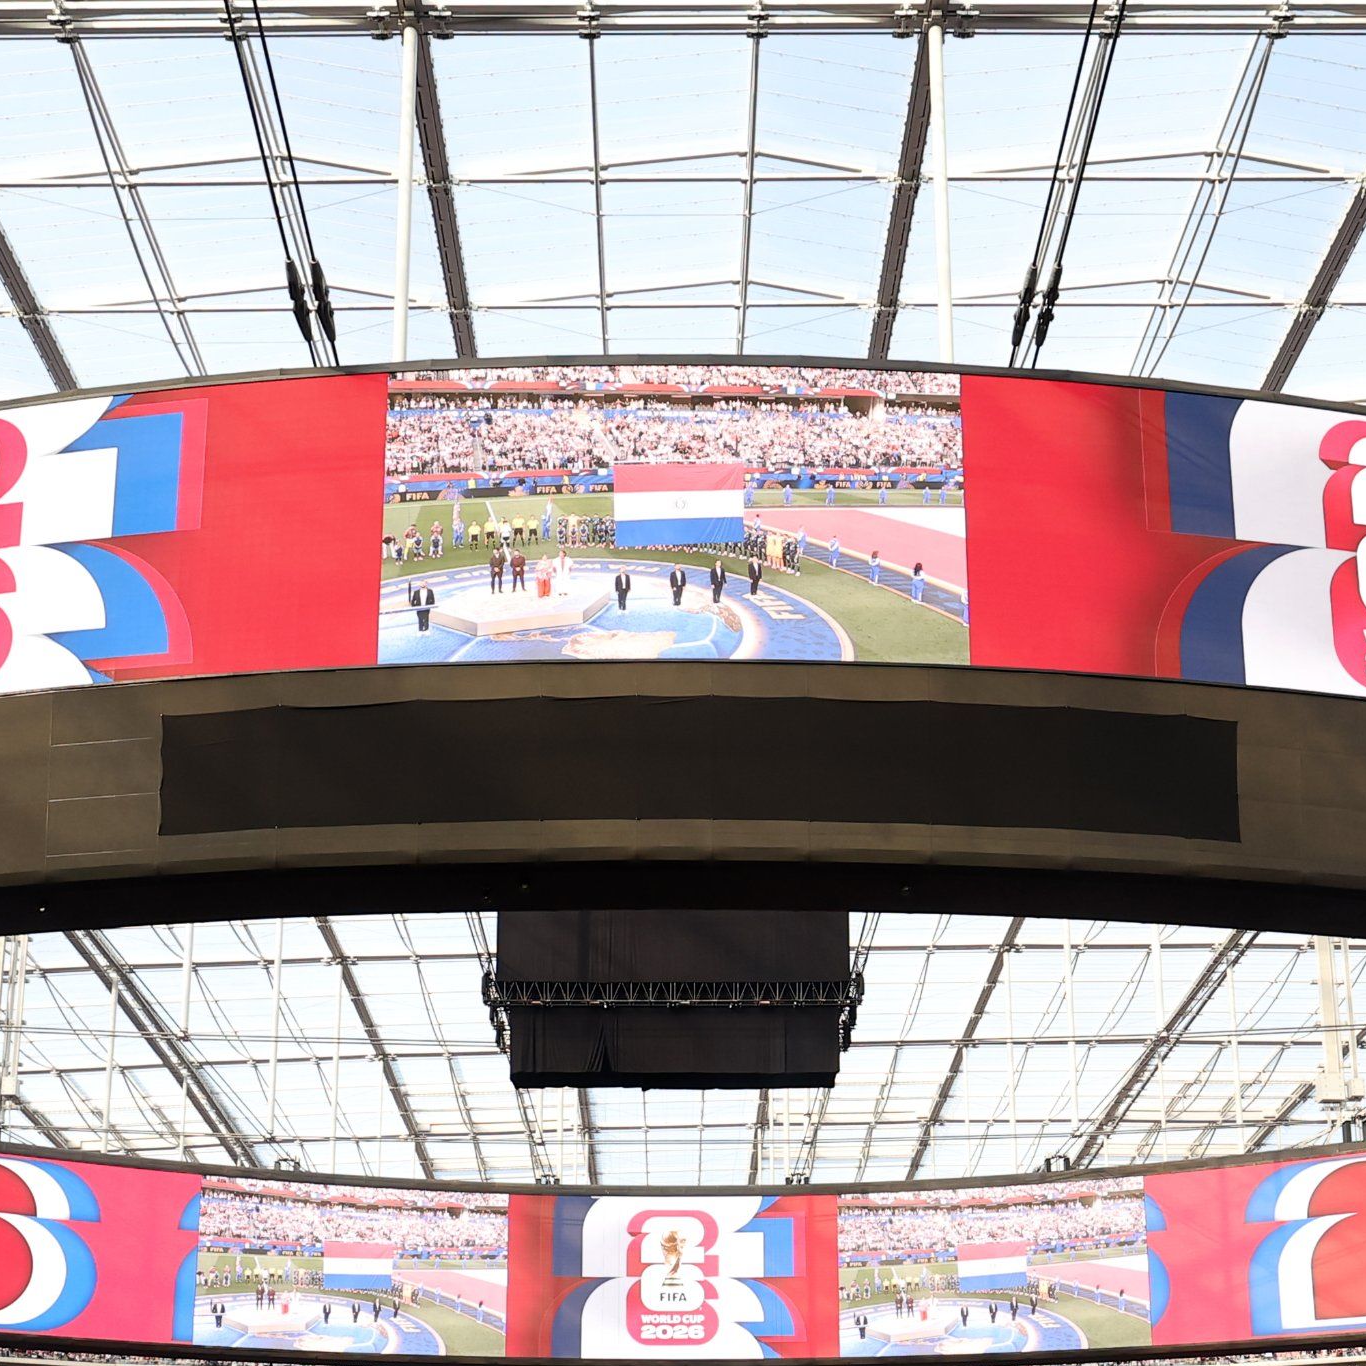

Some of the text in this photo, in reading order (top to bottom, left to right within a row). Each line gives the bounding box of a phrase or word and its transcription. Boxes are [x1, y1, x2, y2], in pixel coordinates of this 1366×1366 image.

[536, 486, 557, 494] FIFA
[406, 492, 430, 501] FIFA
[660, 1293, 686, 1301] FIFA
[640, 1314, 705, 1324] WORLD CUP
[640, 1325, 705, 1340] 2026
